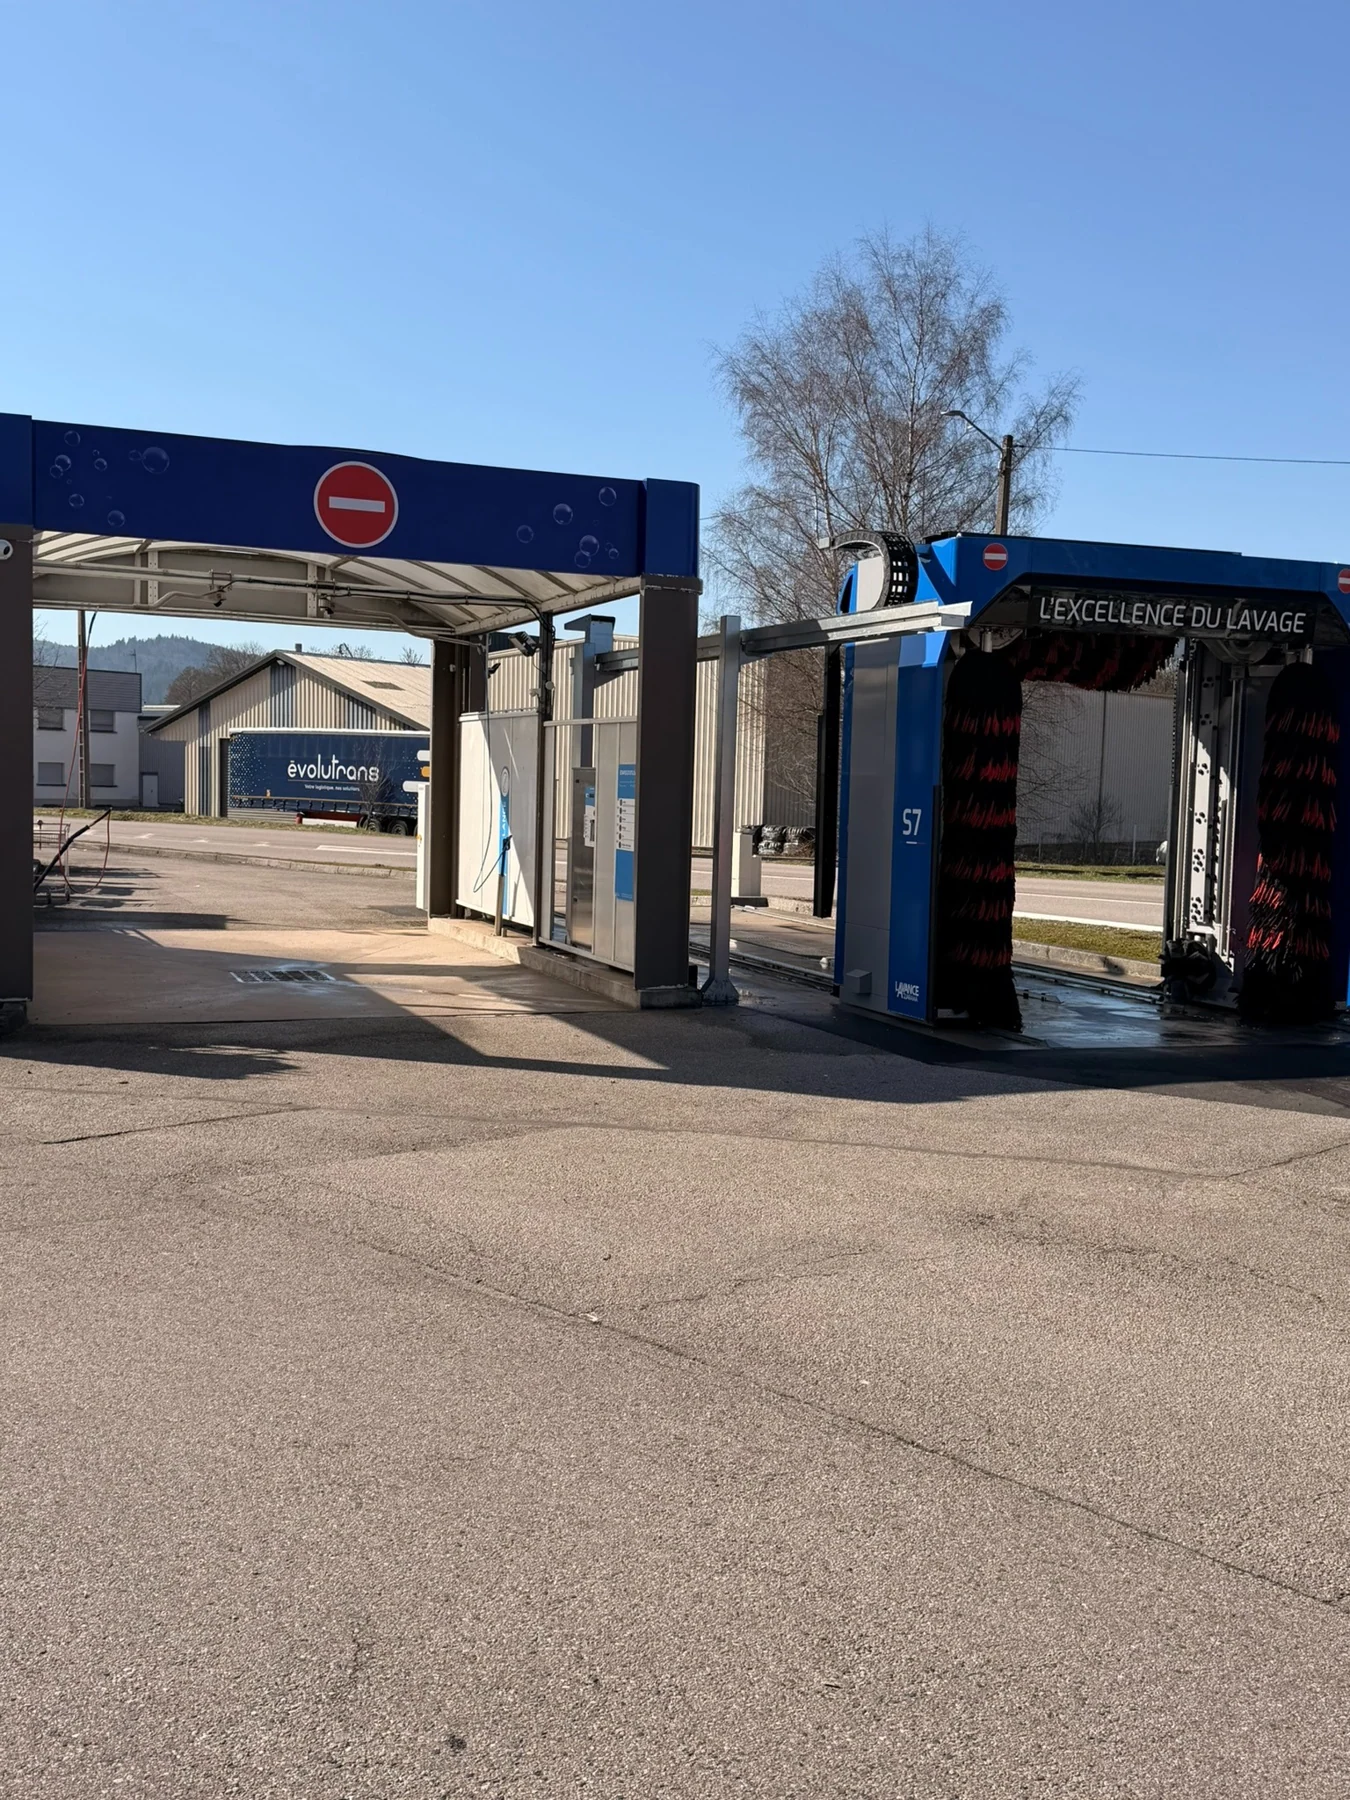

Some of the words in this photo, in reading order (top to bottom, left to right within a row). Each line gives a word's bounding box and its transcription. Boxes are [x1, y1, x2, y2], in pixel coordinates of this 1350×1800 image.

[1039, 597, 1185, 627] L'EXCELLENCE
[1190, 606, 1222, 629] DU
[1226, 608, 1306, 634] LAVAGE
[902, 808, 922, 836] S7
